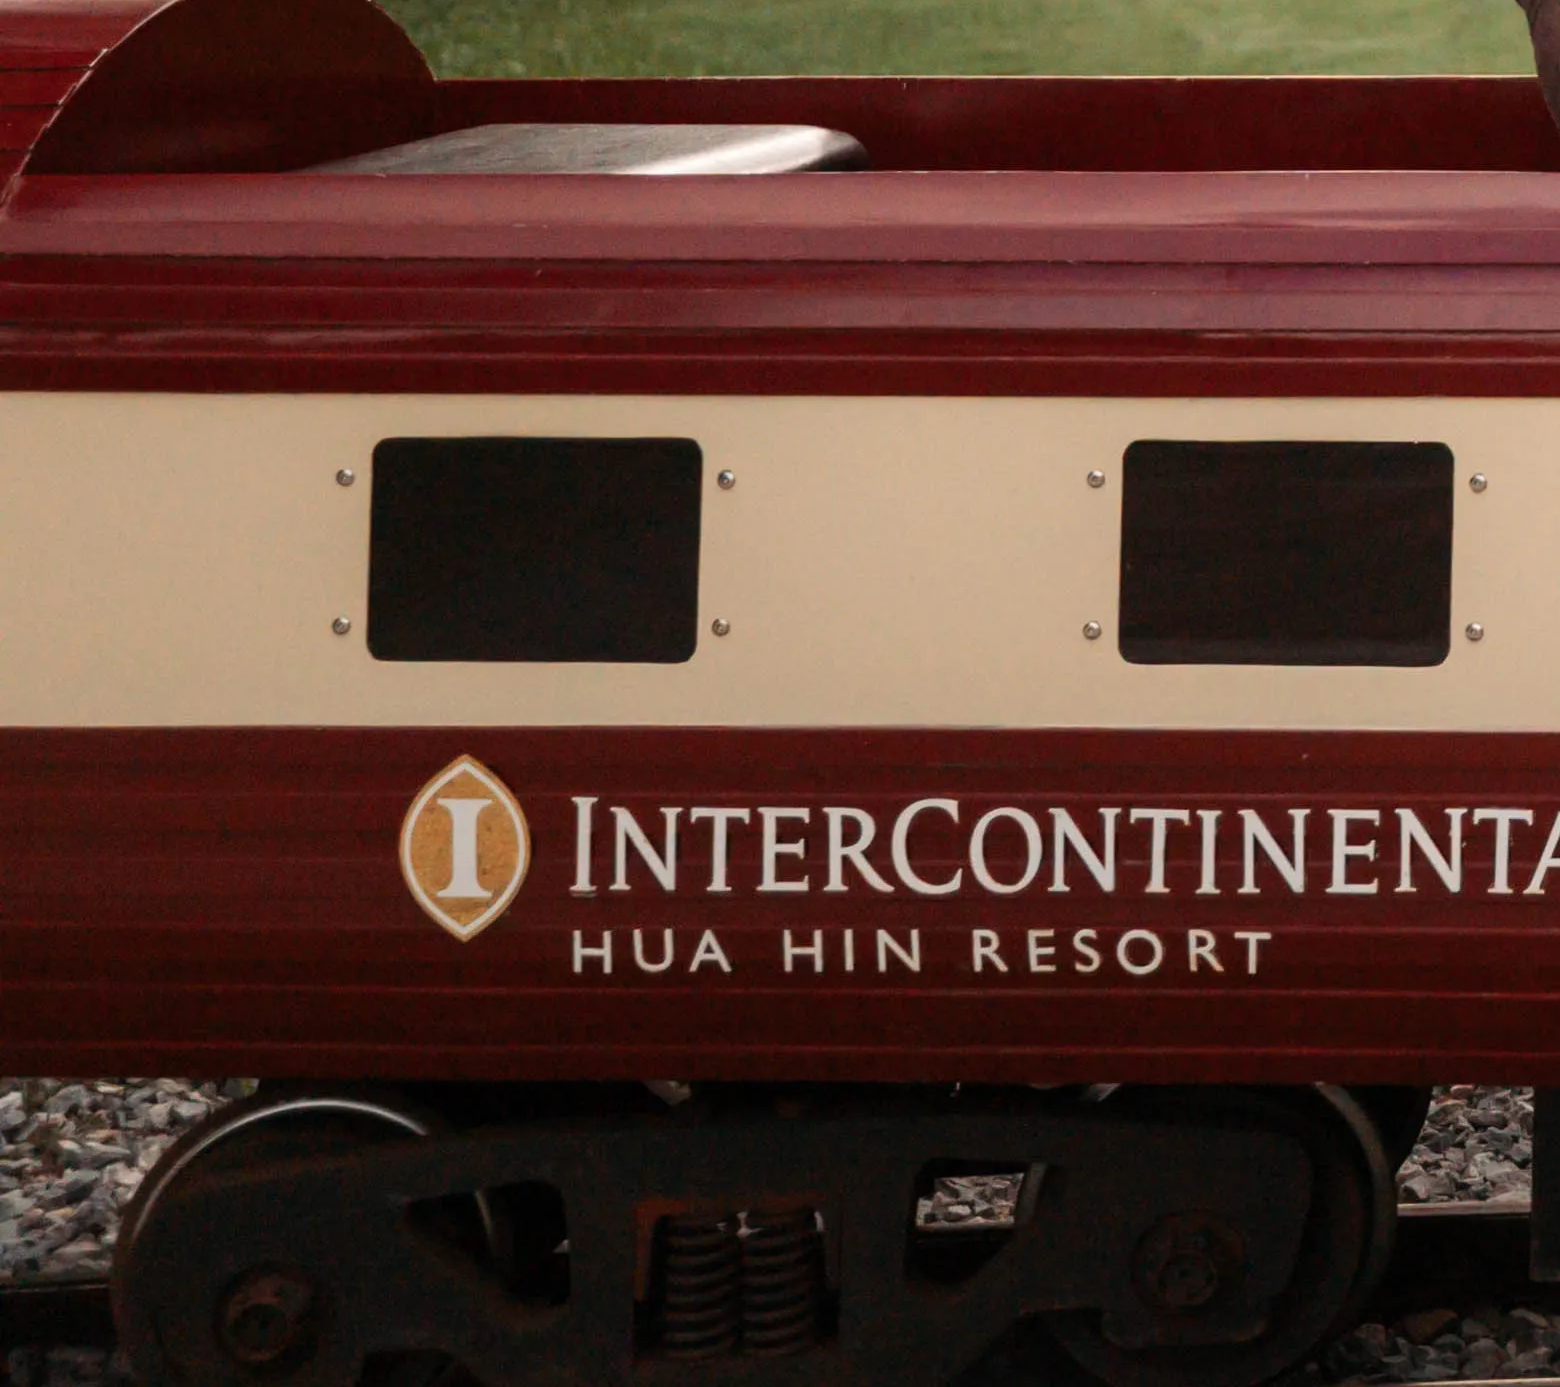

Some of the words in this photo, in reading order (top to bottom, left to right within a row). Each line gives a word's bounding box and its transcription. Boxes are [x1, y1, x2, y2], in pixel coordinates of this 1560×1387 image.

[436, 797, 494, 899] I
[573, 928, 731, 974] HUA
[783, 928, 920, 973] HIN
[972, 928, 1272, 975] RESORT
